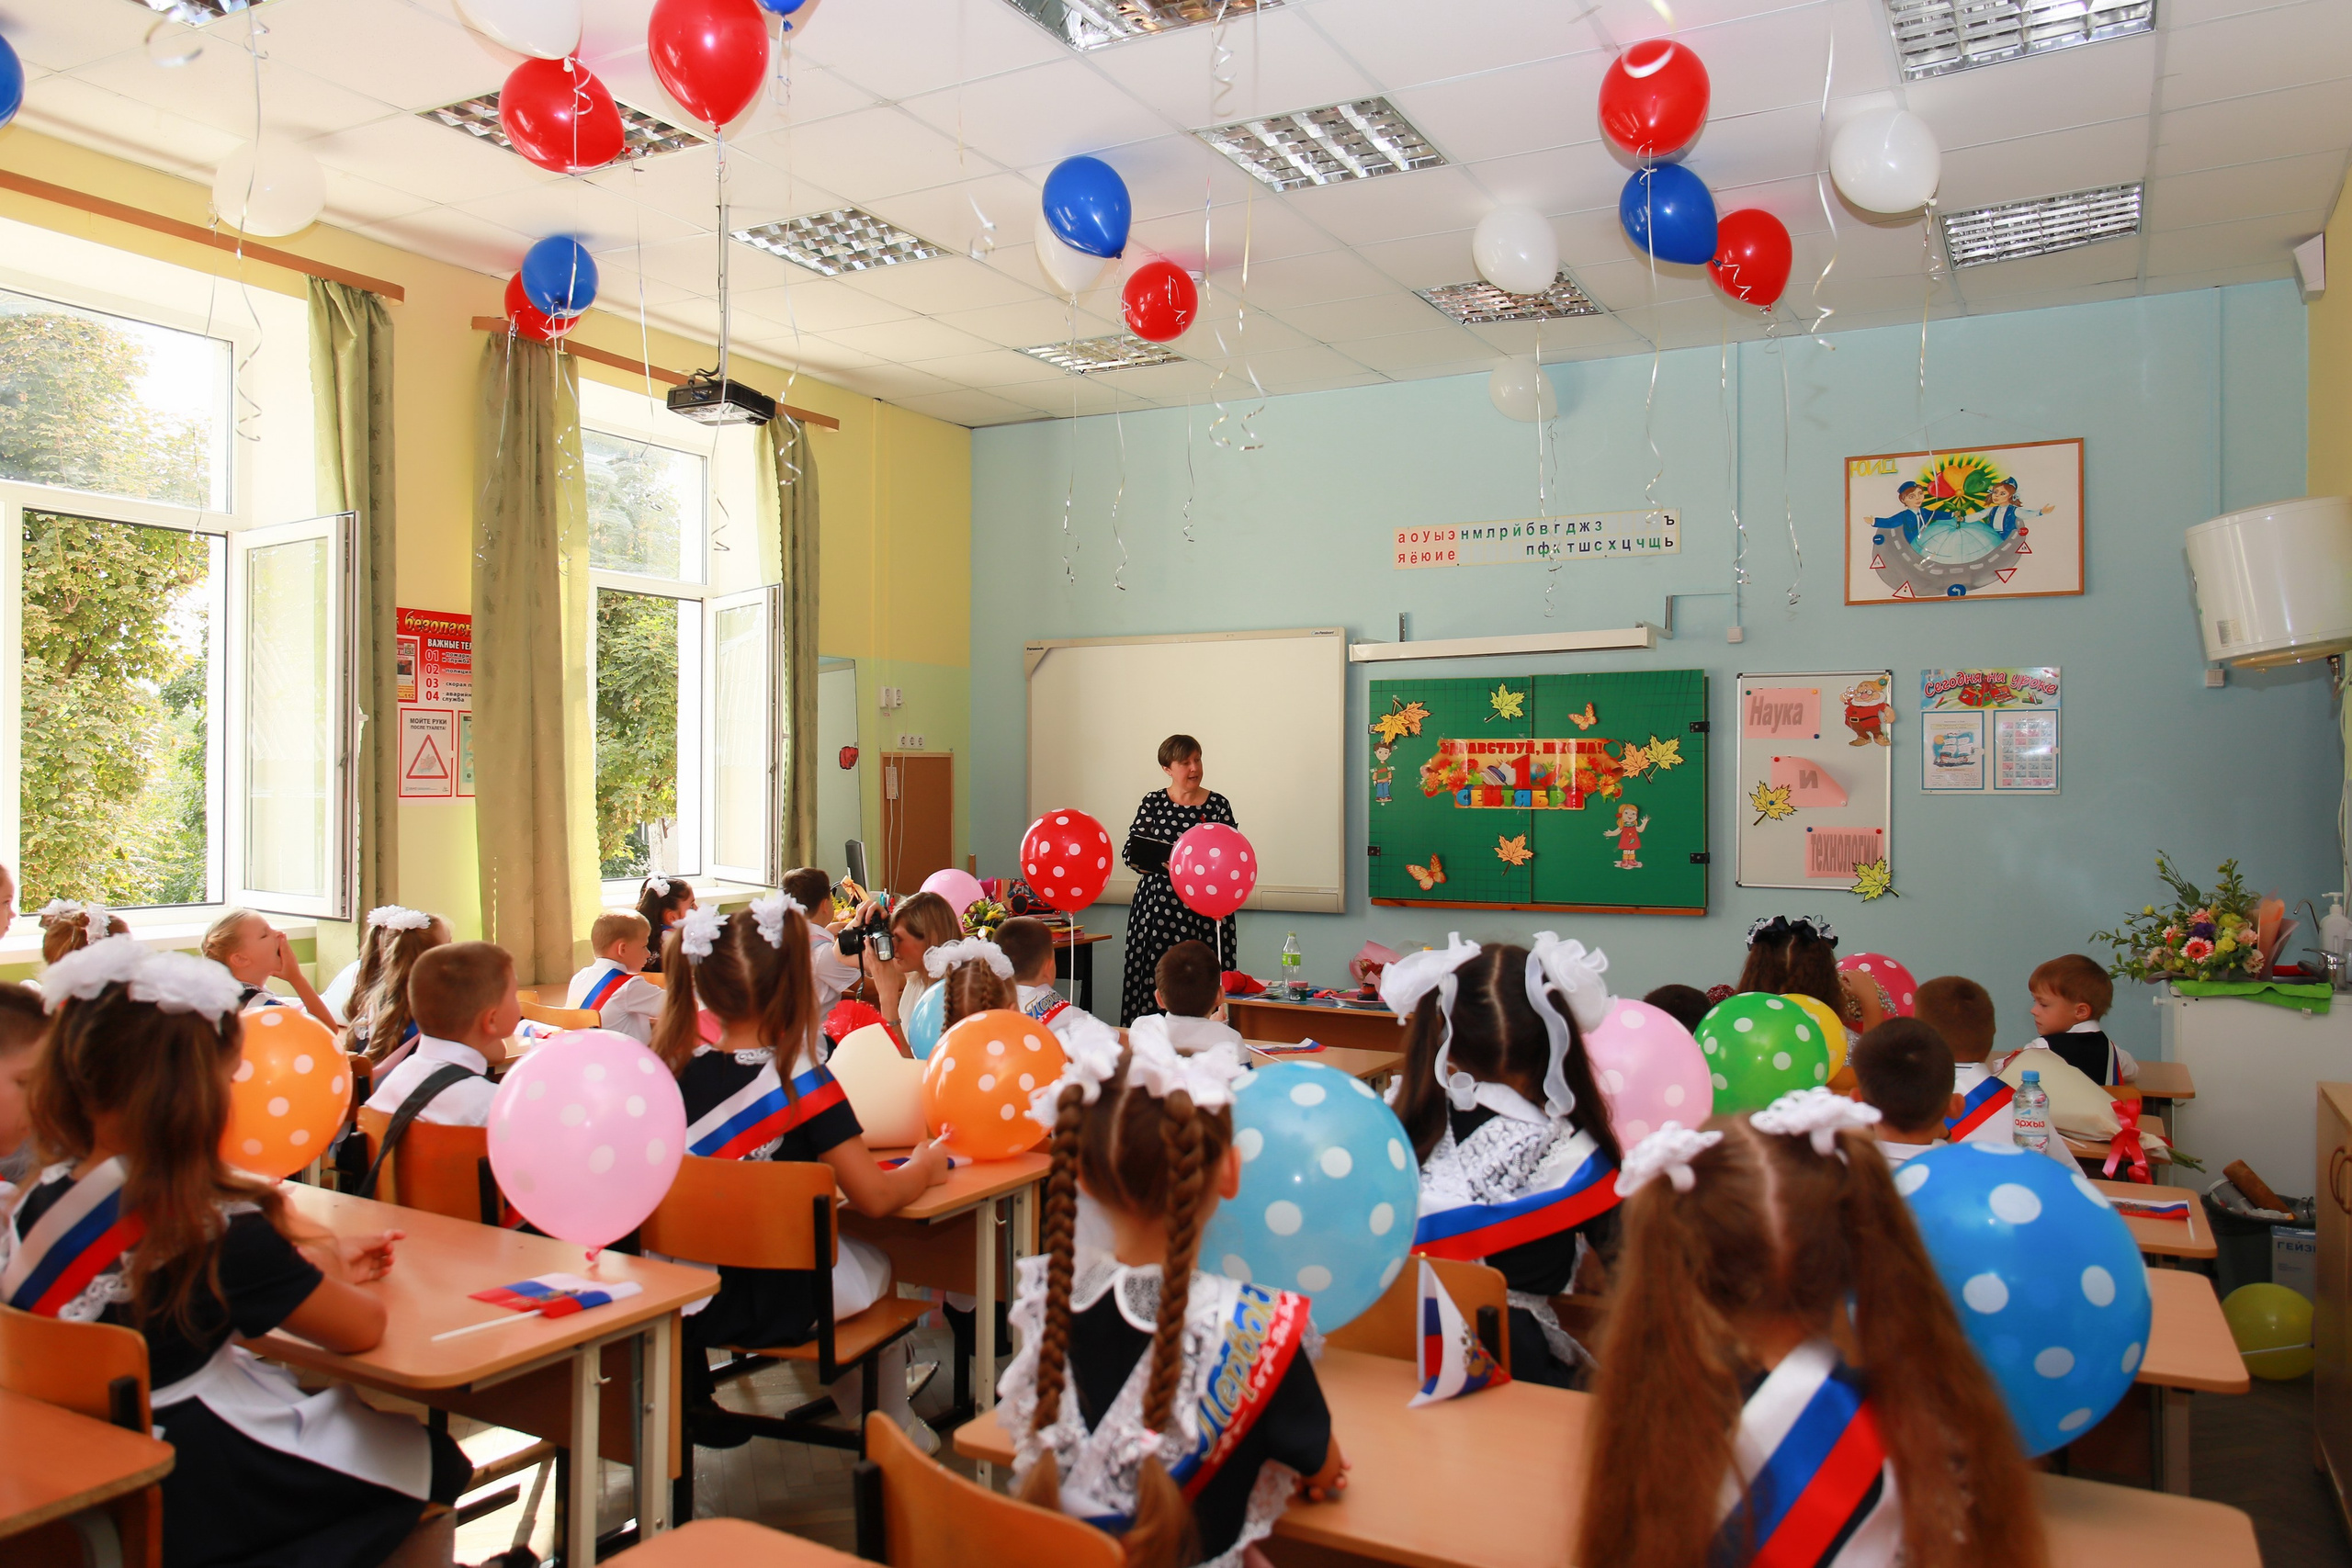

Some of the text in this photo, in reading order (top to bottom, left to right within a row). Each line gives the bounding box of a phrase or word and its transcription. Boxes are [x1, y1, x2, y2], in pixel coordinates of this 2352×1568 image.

[1849, 459, 1898, 478] ЮИД
[427, 638, 460, 650] ВАЖНЫЕ
[425, 649, 439, 661] 01
[425, 664, 440, 675] 02
[425, 678, 439, 689] 03
[1924, 671, 2058, 698] Сегодня на уроке
[425, 691, 440, 701] 04
[1749, 695, 1804, 734] Наука
[1440, 740, 1603, 755] ЗДРАВСТВУЙ, ШКОЛА!
[1799, 770, 1818, 789] и
[1455, 787, 1584, 808] СЕНТЯБРЯ
[1810, 833, 1879, 873] технологии
[2014, 1118, 2045, 1128] архыз
